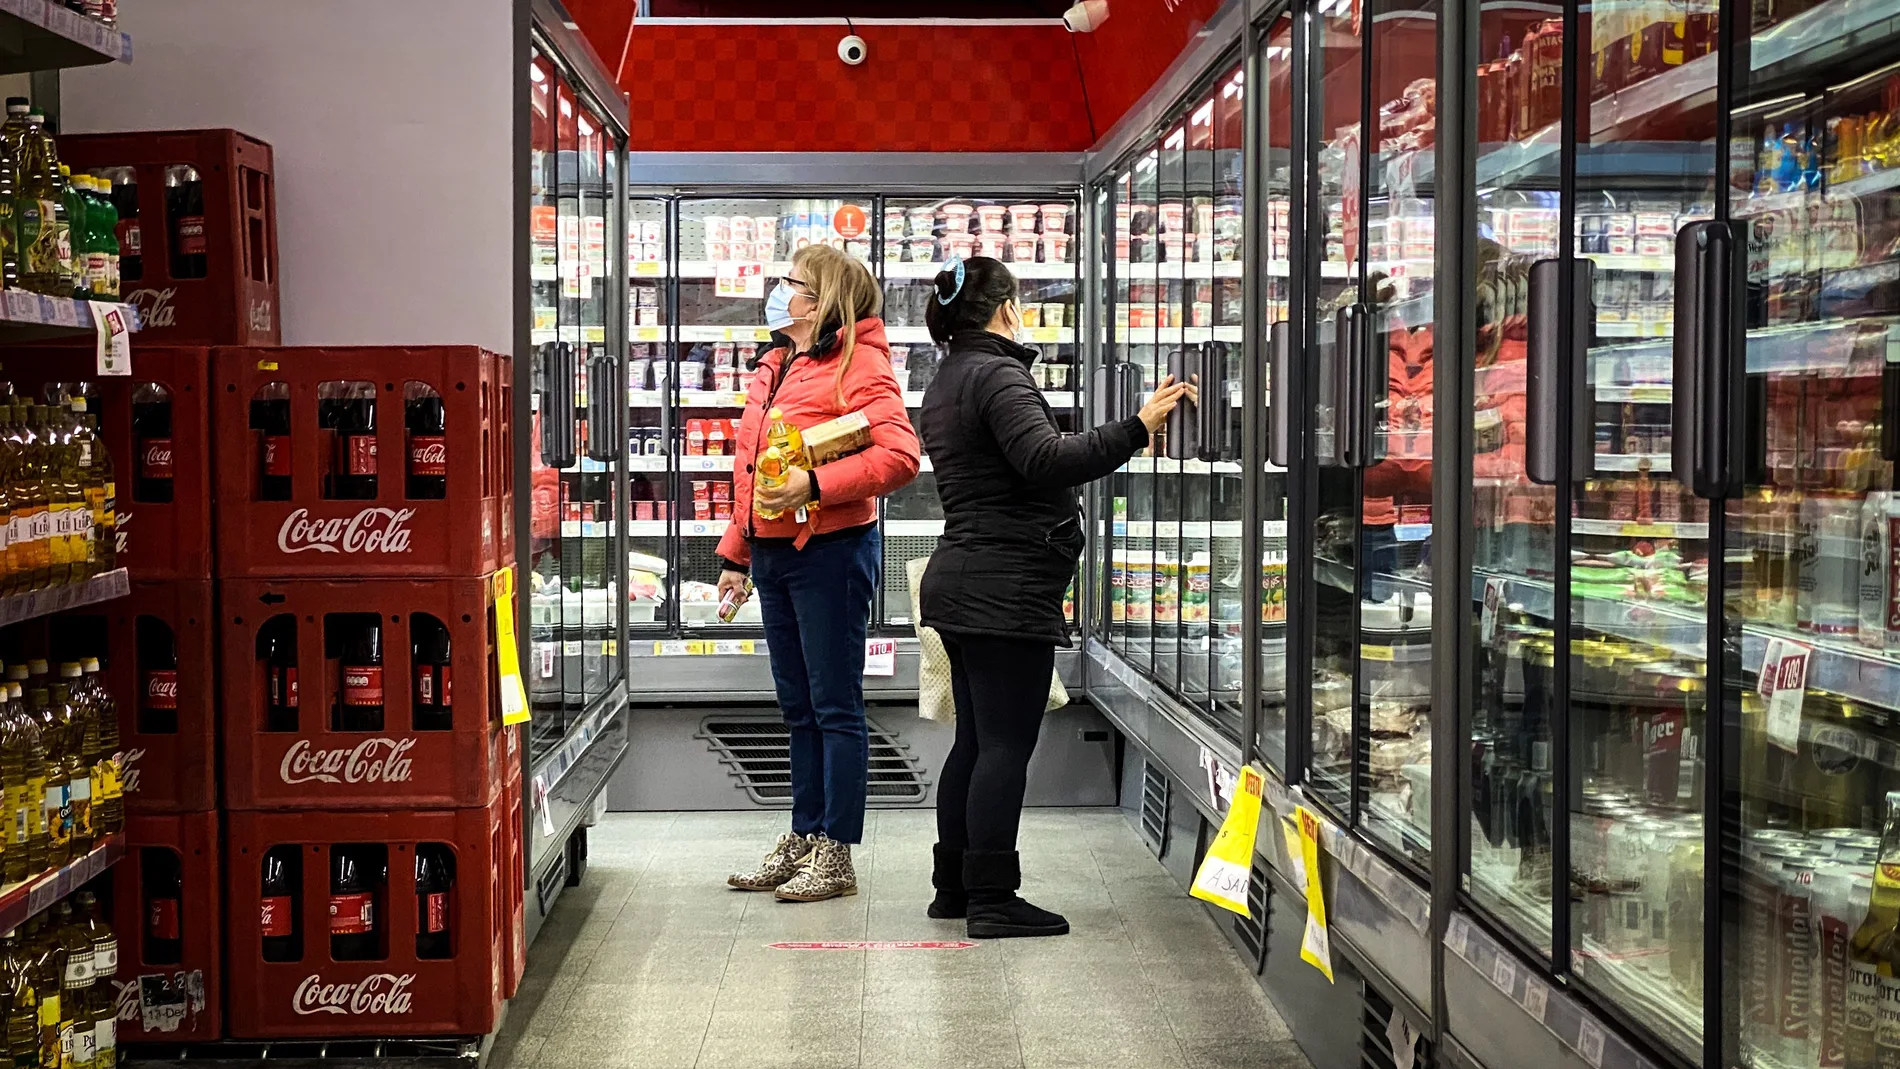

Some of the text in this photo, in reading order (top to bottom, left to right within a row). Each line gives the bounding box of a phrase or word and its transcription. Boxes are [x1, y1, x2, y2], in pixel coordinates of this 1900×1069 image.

[277, 507, 417, 554] Coca-Cola
[280, 737, 417, 784] Coca-Cola
[292, 972, 417, 1015] Coca-Cola
